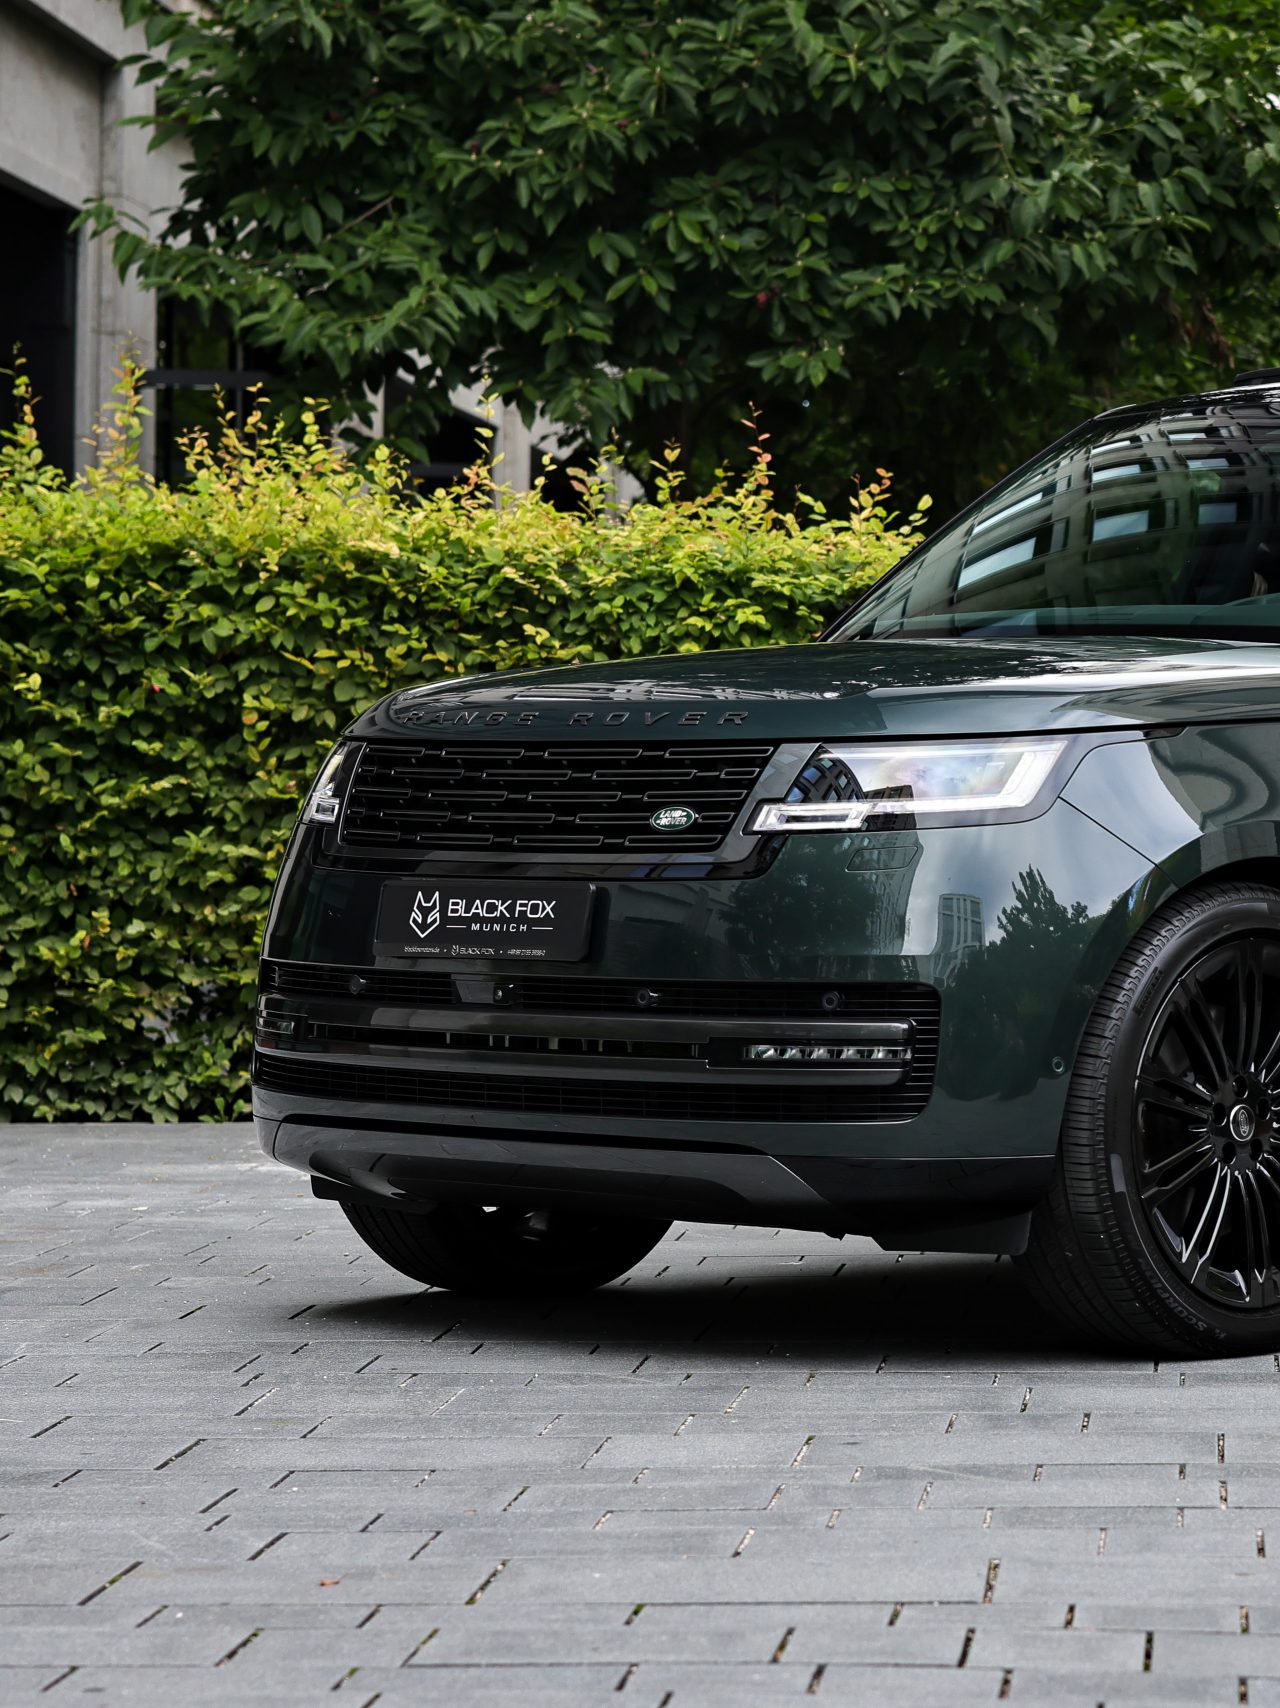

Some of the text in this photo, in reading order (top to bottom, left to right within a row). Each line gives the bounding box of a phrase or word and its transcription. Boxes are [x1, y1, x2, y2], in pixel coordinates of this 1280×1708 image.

[402, 711, 749, 726] RANGE ROVER
[659, 809, 683, 818] LAND
[659, 817, 687, 826] ROVER
[447, 898, 557, 919] BLACK FOX
[470, 922, 527, 932] MUNICH
